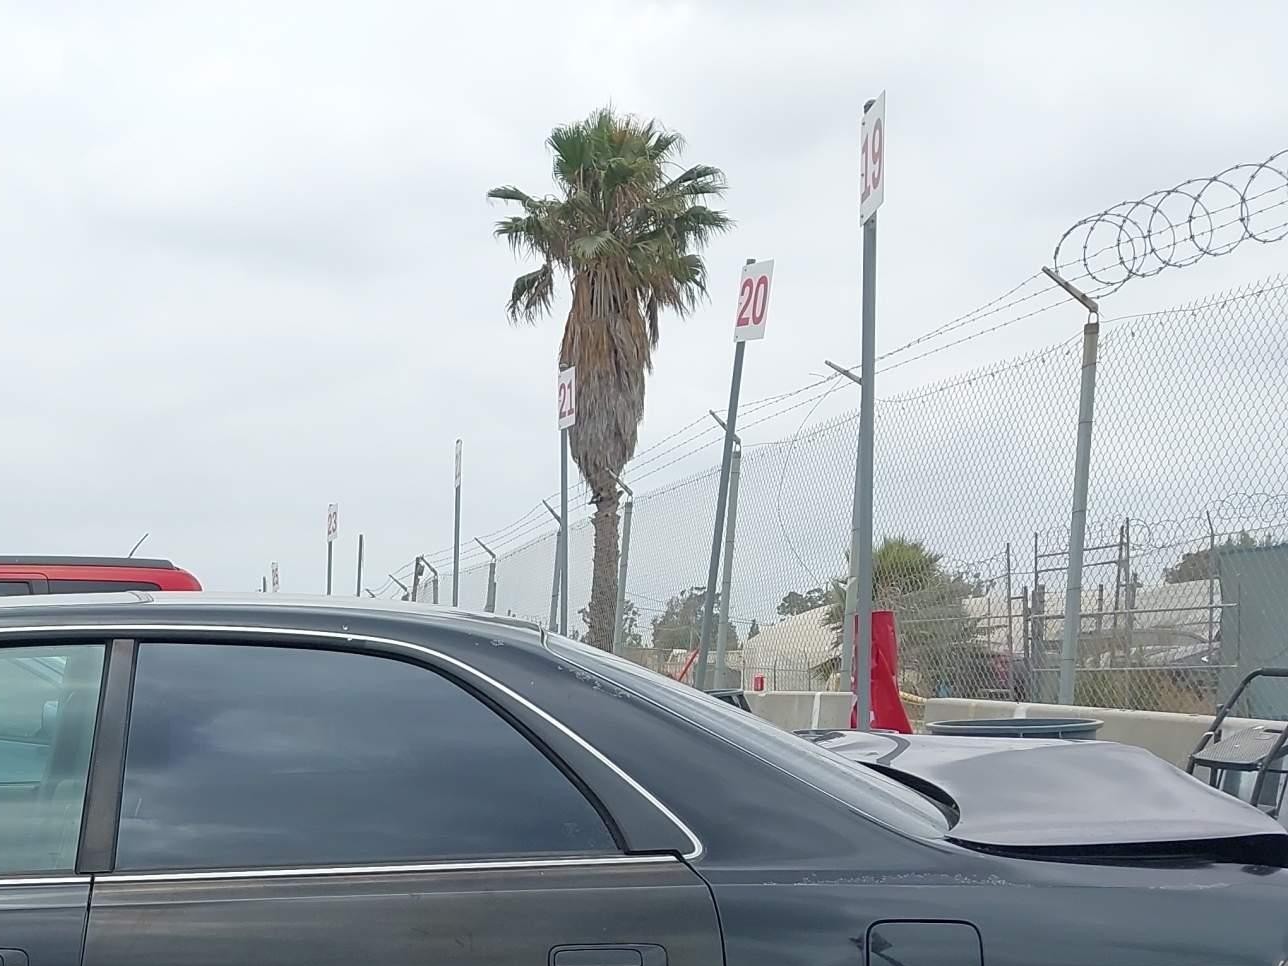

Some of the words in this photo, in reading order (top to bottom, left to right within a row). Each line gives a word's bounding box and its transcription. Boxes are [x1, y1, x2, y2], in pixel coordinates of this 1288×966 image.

[861, 118, 883, 204] 19
[736, 275, 768, 327] 20
[559, 379, 575, 419] 21
[328, 511, 337, 535] 23
